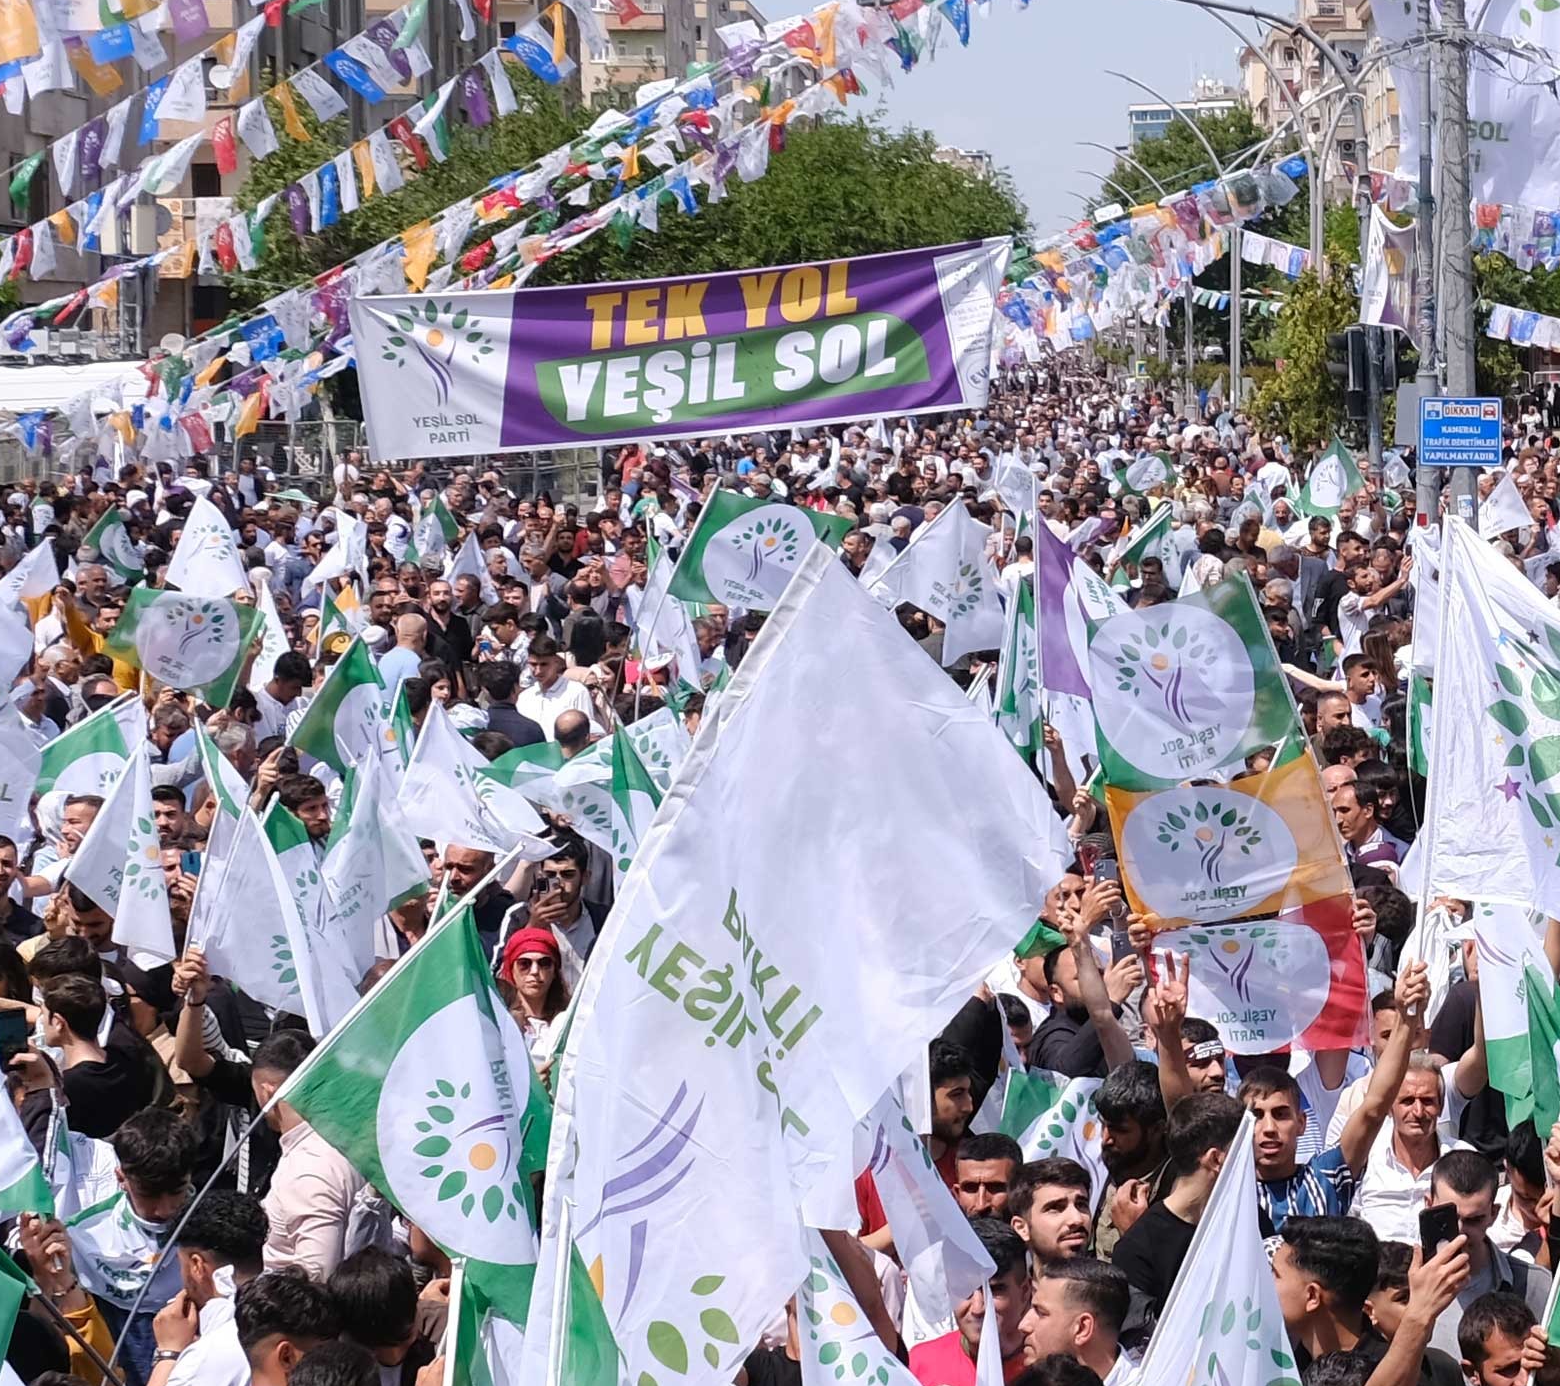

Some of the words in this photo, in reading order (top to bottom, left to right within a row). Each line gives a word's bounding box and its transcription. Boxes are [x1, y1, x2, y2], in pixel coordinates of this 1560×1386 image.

[585, 281, 707, 350] TEK
[739, 261, 858, 329] YOL
[557, 340, 745, 425] YEŞİL
[773, 316, 897, 393] SOL
[1444, 403, 1479, 417] DİKKAT!
[412, 413, 454, 430] YEŞİL
[455, 413, 484, 426] SOL
[430, 429, 472, 445] PARTİ
